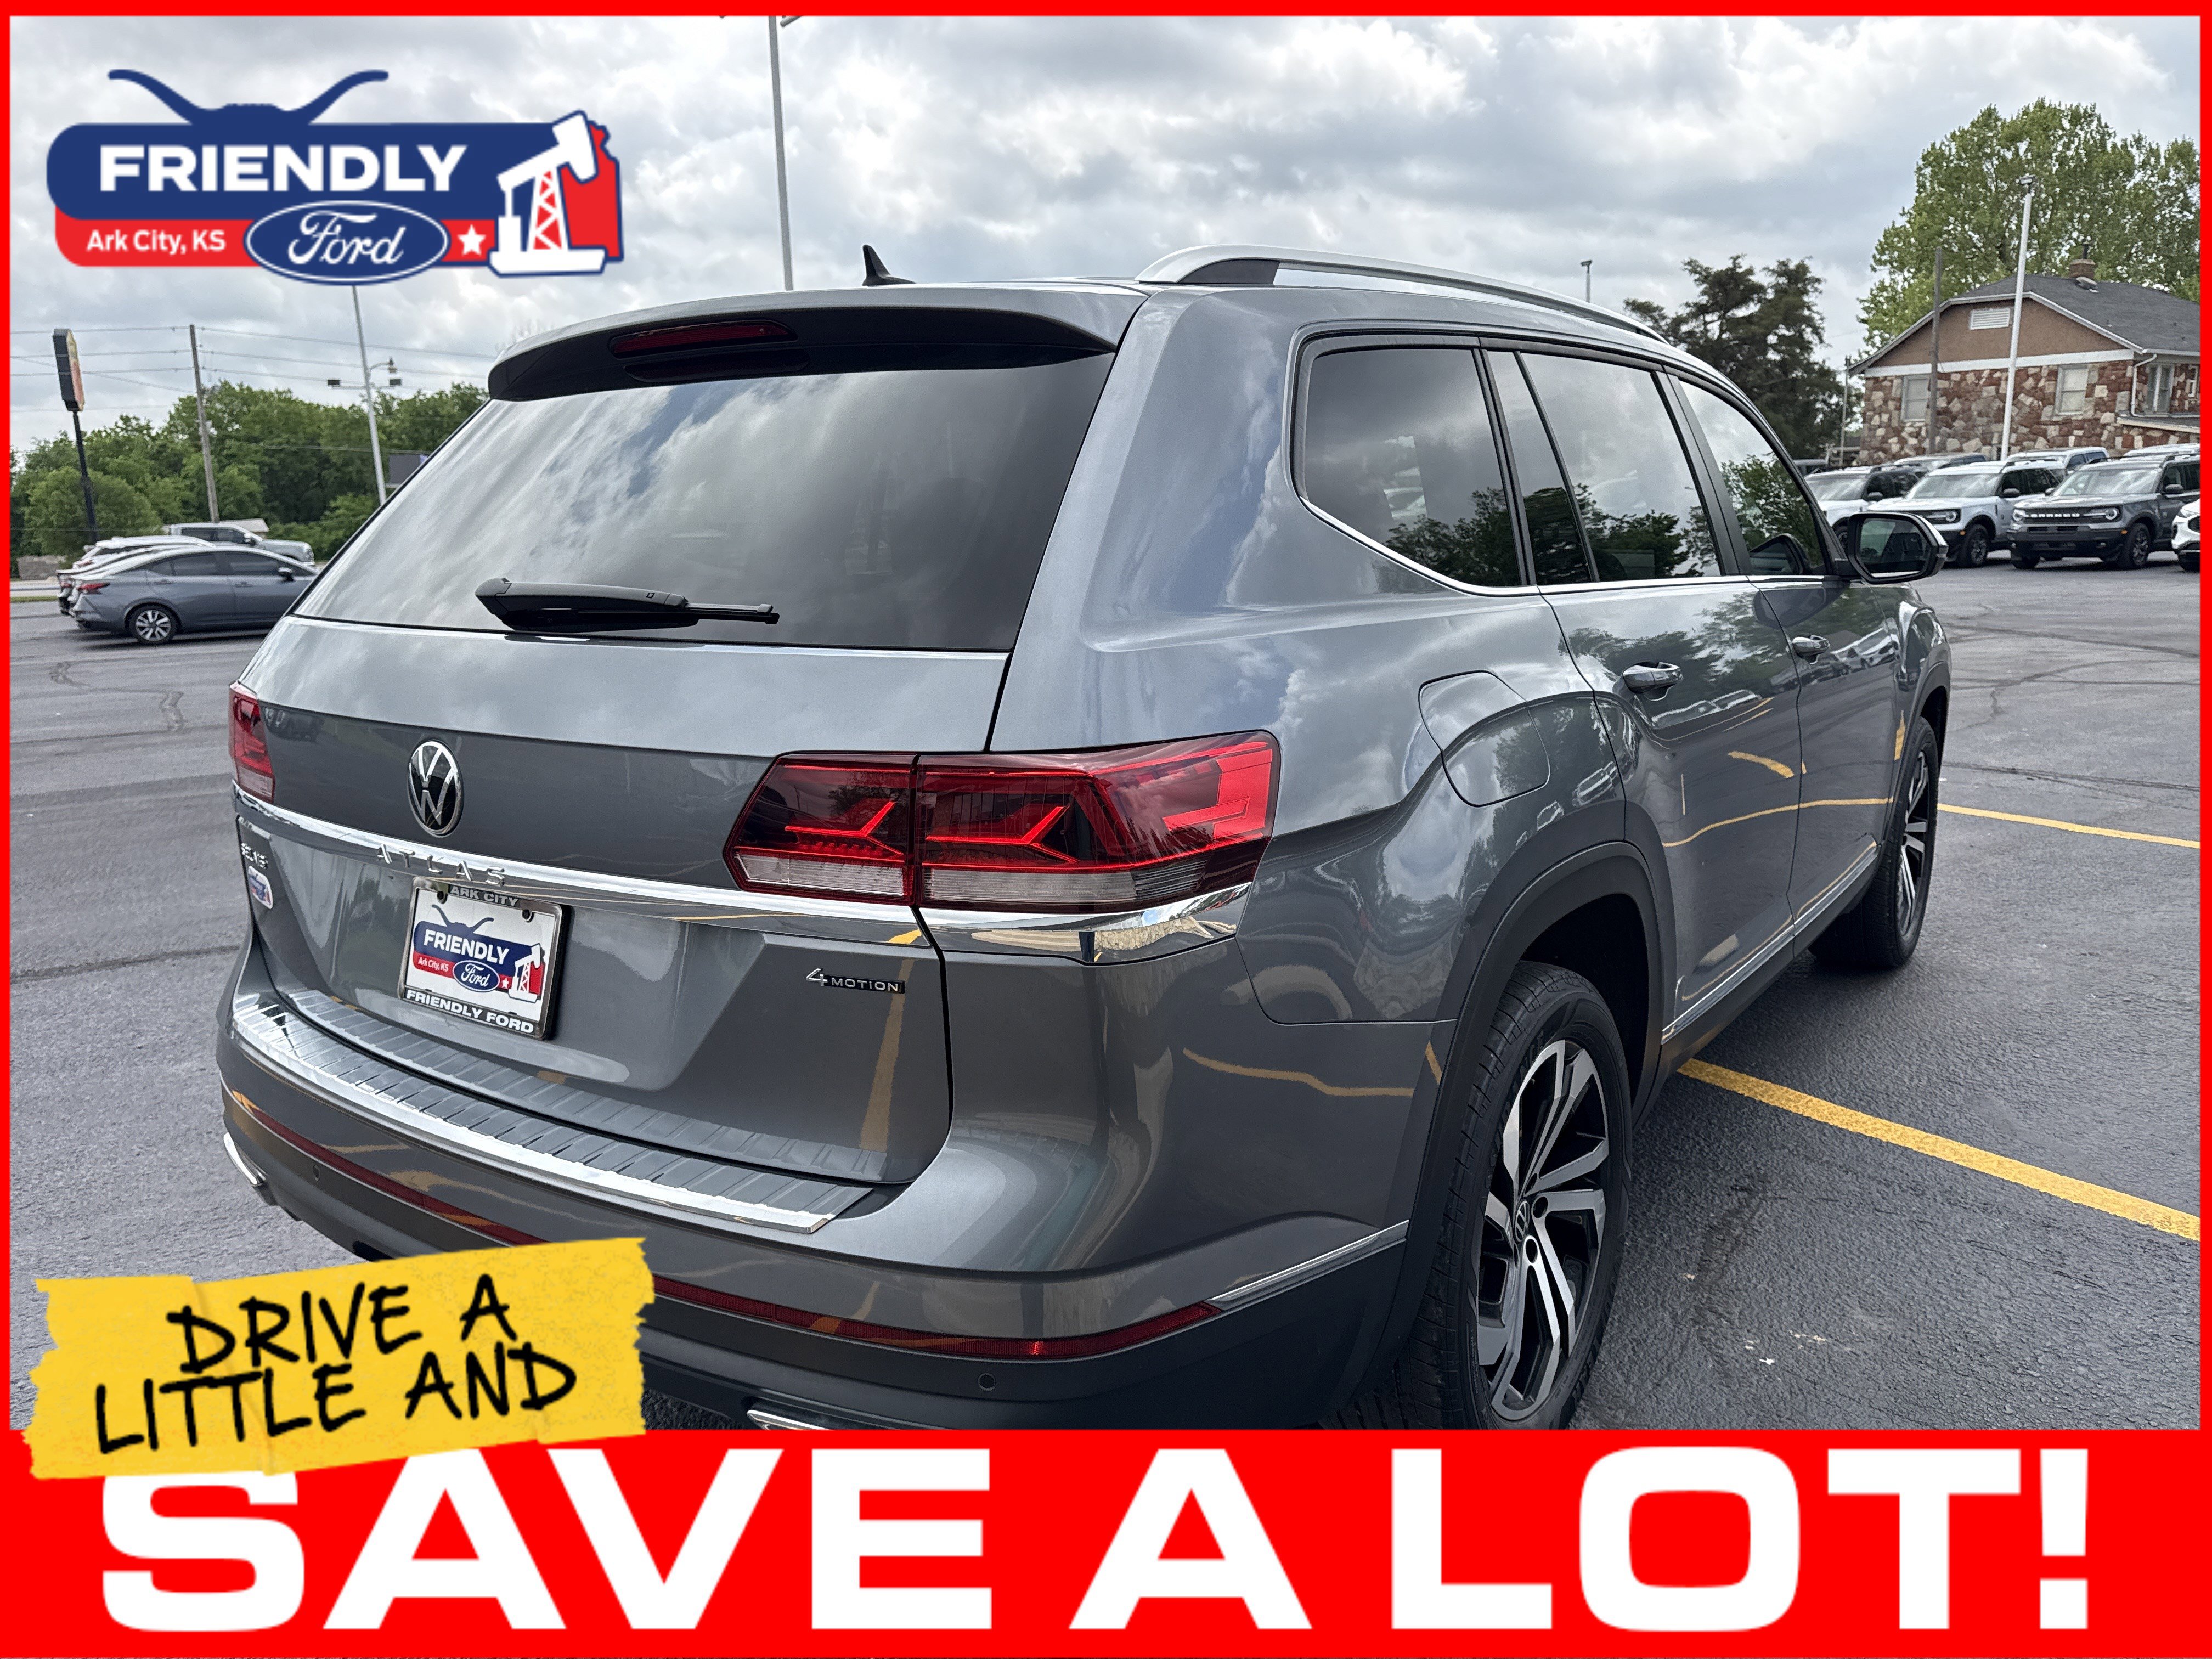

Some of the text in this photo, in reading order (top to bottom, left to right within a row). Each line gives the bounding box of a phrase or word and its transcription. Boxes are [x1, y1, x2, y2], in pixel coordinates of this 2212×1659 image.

[376, 843, 505, 887] ATLAS
[450, 885, 519, 907] ARK CITY
[424, 929, 511, 965] FRIENDLY
[418, 956, 427, 966] Ark
[440, 963, 449, 973] KS
[461, 962, 489, 988] Ford
[805, 968, 899, 992] 4MOTION
[406, 991, 534, 1034] FRIENDLY FORD
